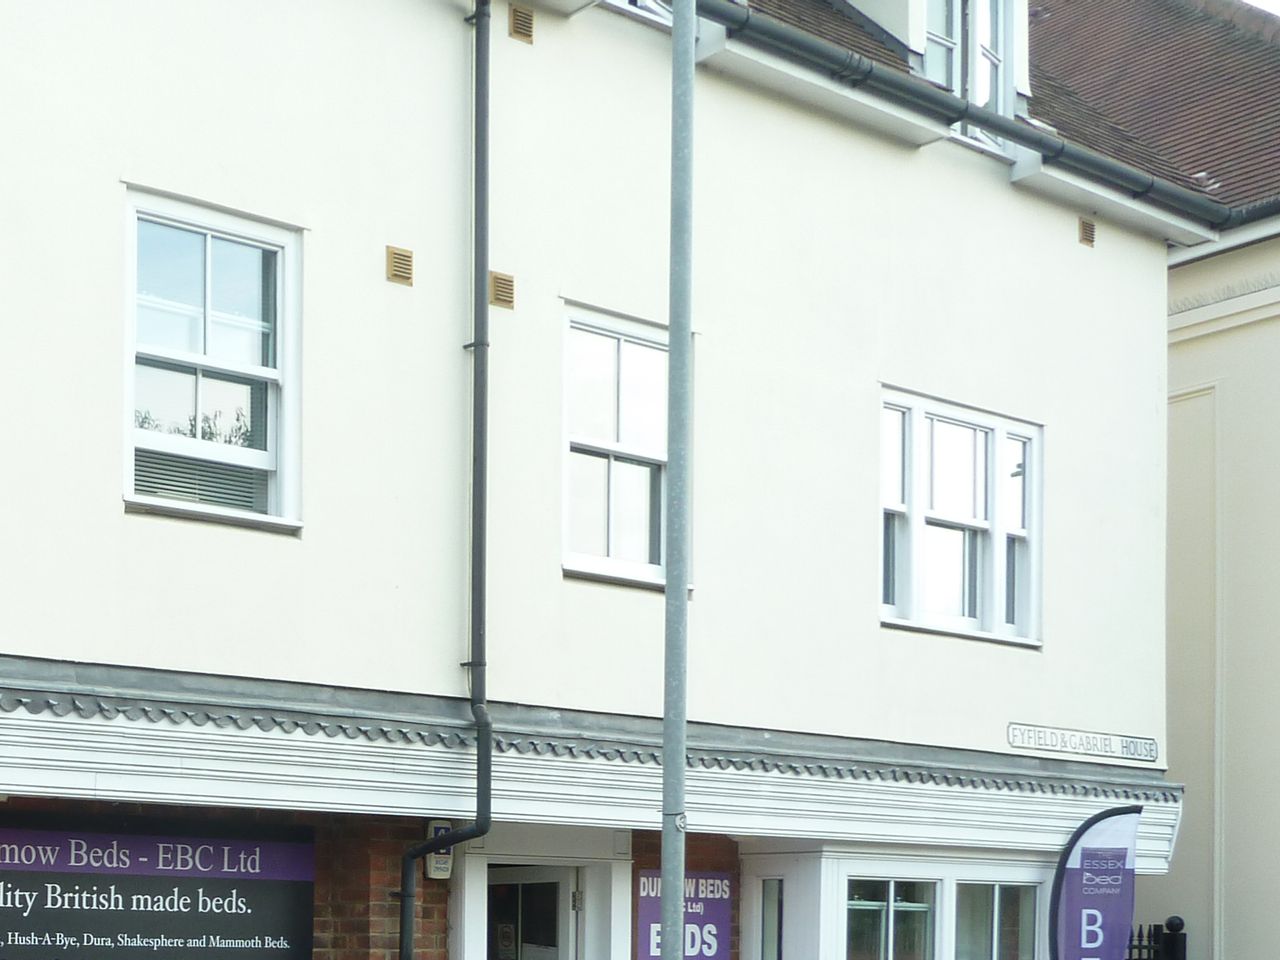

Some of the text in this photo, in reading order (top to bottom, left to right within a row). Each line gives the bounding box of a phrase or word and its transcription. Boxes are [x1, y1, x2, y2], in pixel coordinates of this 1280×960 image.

[1011, 727, 1058, 748] FYFIELD
[1070, 734, 1116, 754] GABRIEL
[1120, 738, 1156, 759] HOUSE
[67, 839, 131, 869] Beds
[155, 843, 215, 872] EBC
[221, 846, 261, 874] Ltd
[1082, 859, 1124, 870] ESSEX
[43, 883, 125, 911] British
[130, 886, 191, 913] made
[197, 887, 253, 914] beds.
[698, 878, 730, 899] BEDS
[7, 931, 81, 950] Hush-A-Bye,
[82, 933, 115, 948] Dura,
[117, 933, 184, 951] Shakesphere
[186, 935, 207, 948] and
[208, 935, 262, 949] Mammoth
[264, 935, 291, 949] Beds.
[649, 923, 718, 957] BDS
